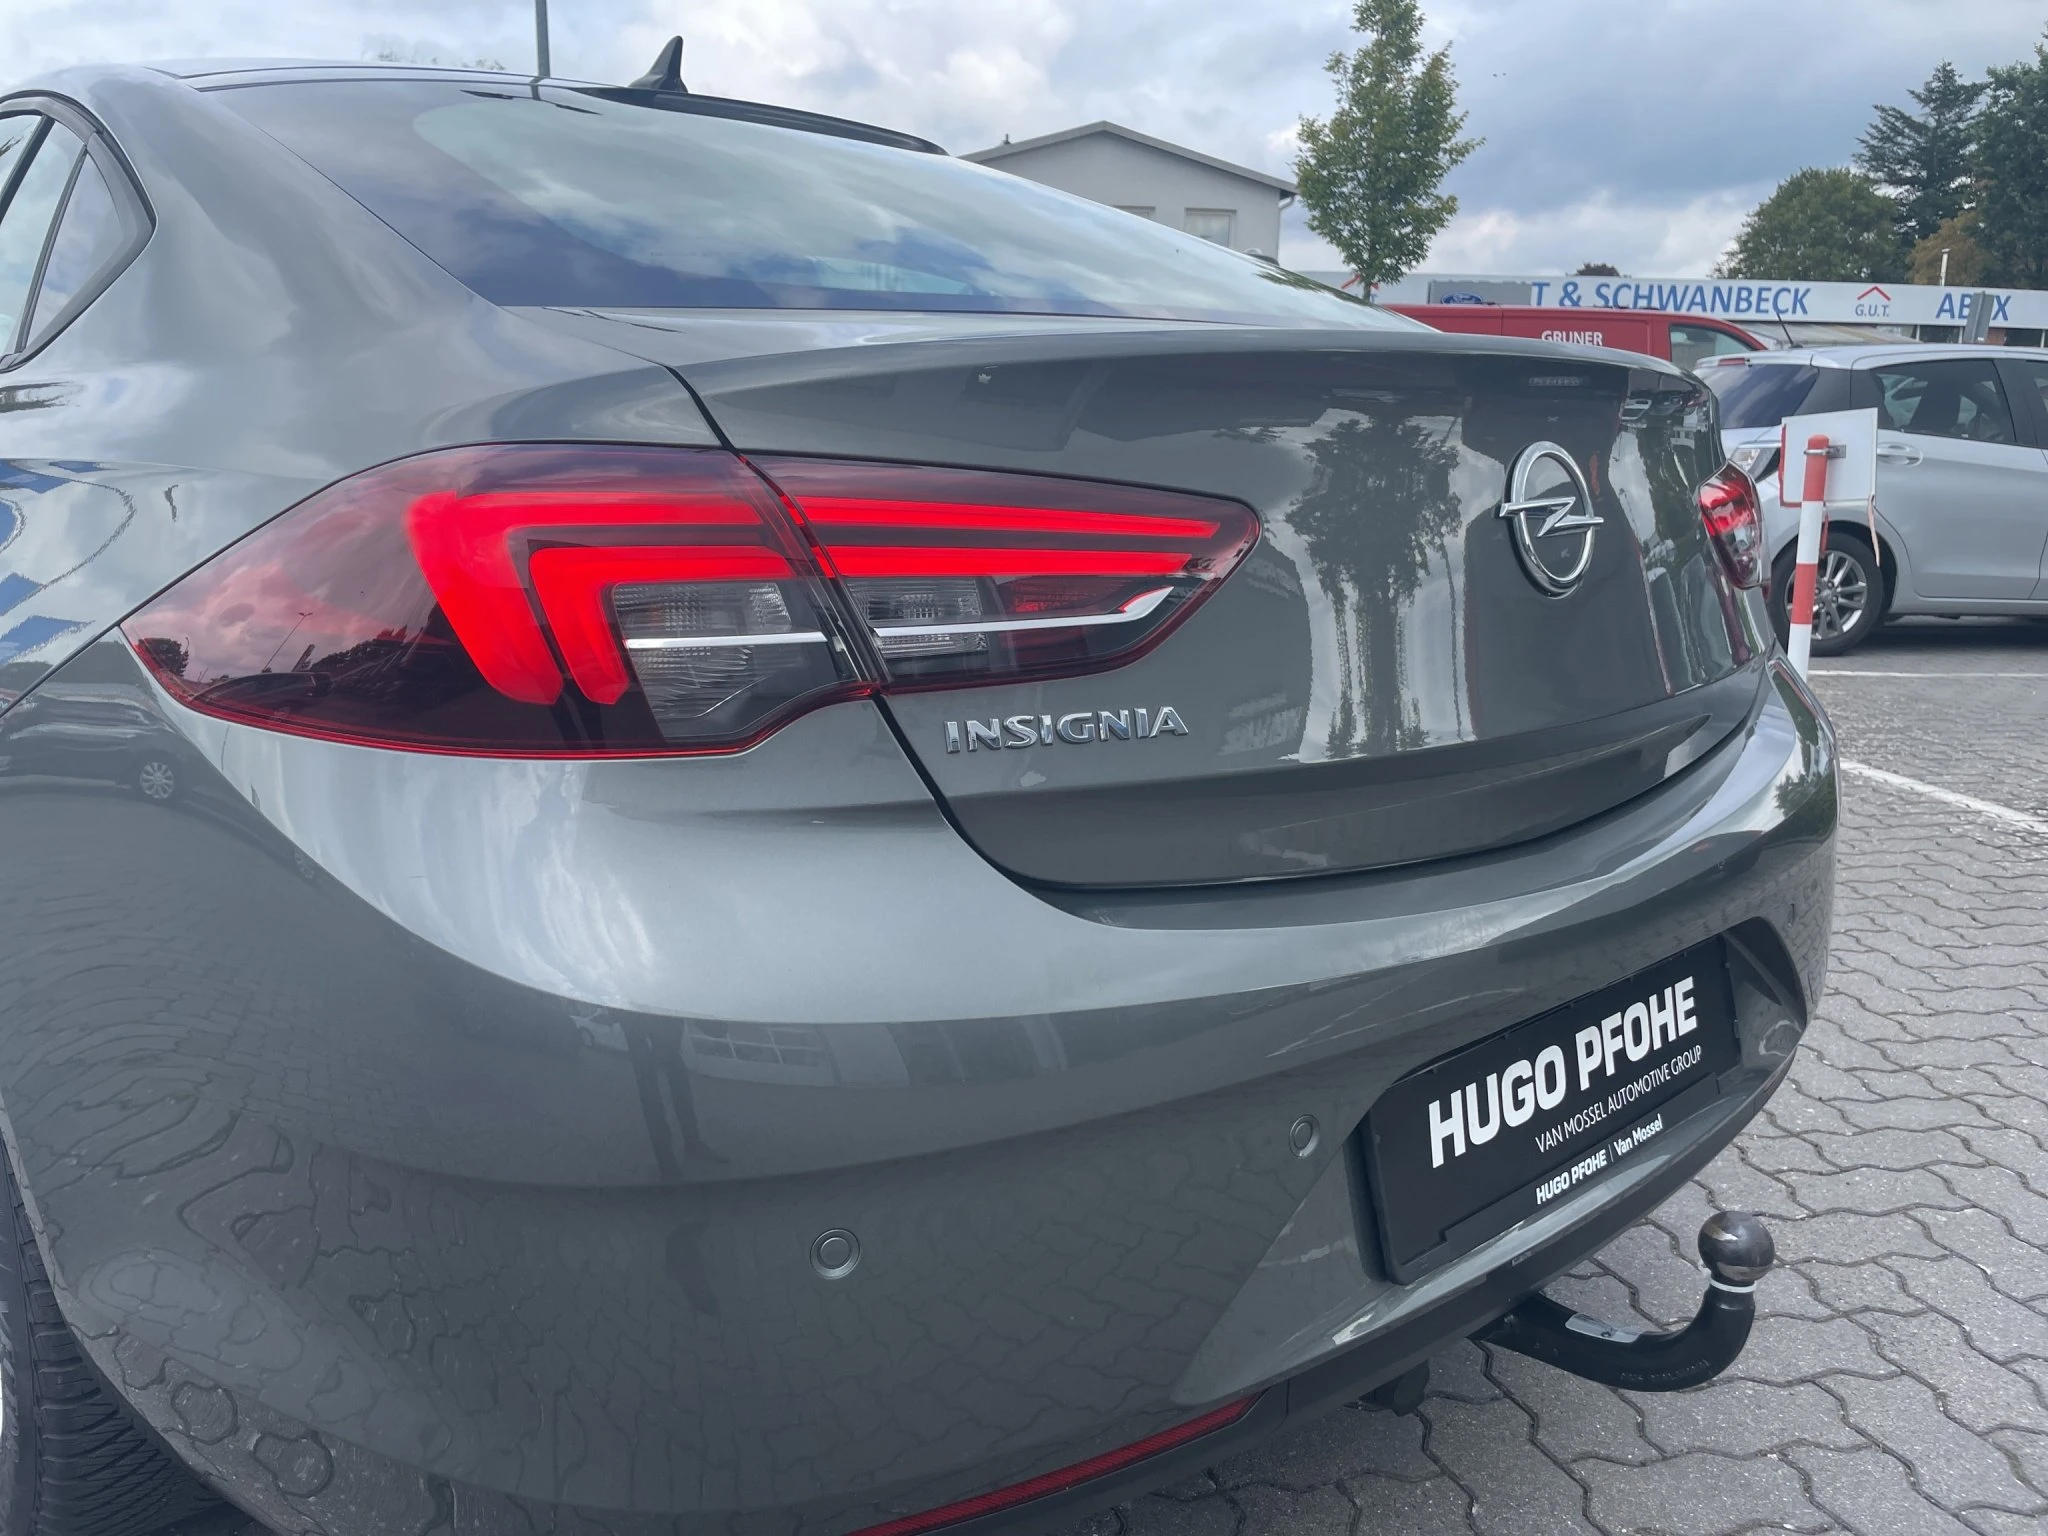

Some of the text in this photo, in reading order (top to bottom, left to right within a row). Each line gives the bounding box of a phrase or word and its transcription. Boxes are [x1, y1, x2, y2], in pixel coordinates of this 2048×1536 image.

[1558, 281, 1582, 307] &
[1595, 283, 1811, 315] SCHWANBECK
[1855, 303, 1890, 318] G.U.T.
[1935, 292, 2012, 321] ABX
[1541, 330, 1603, 347] GRUNER
[944, 706, 1189, 754] INSIGNIA
[1427, 976, 1698, 1169] HUGO PFOHE
[1535, 1044, 1702, 1153] VAN MOSSEL AUTOMOTIVE GROUP
[1536, 1113, 1663, 1205] HUGO PFOHE Van Mossel
